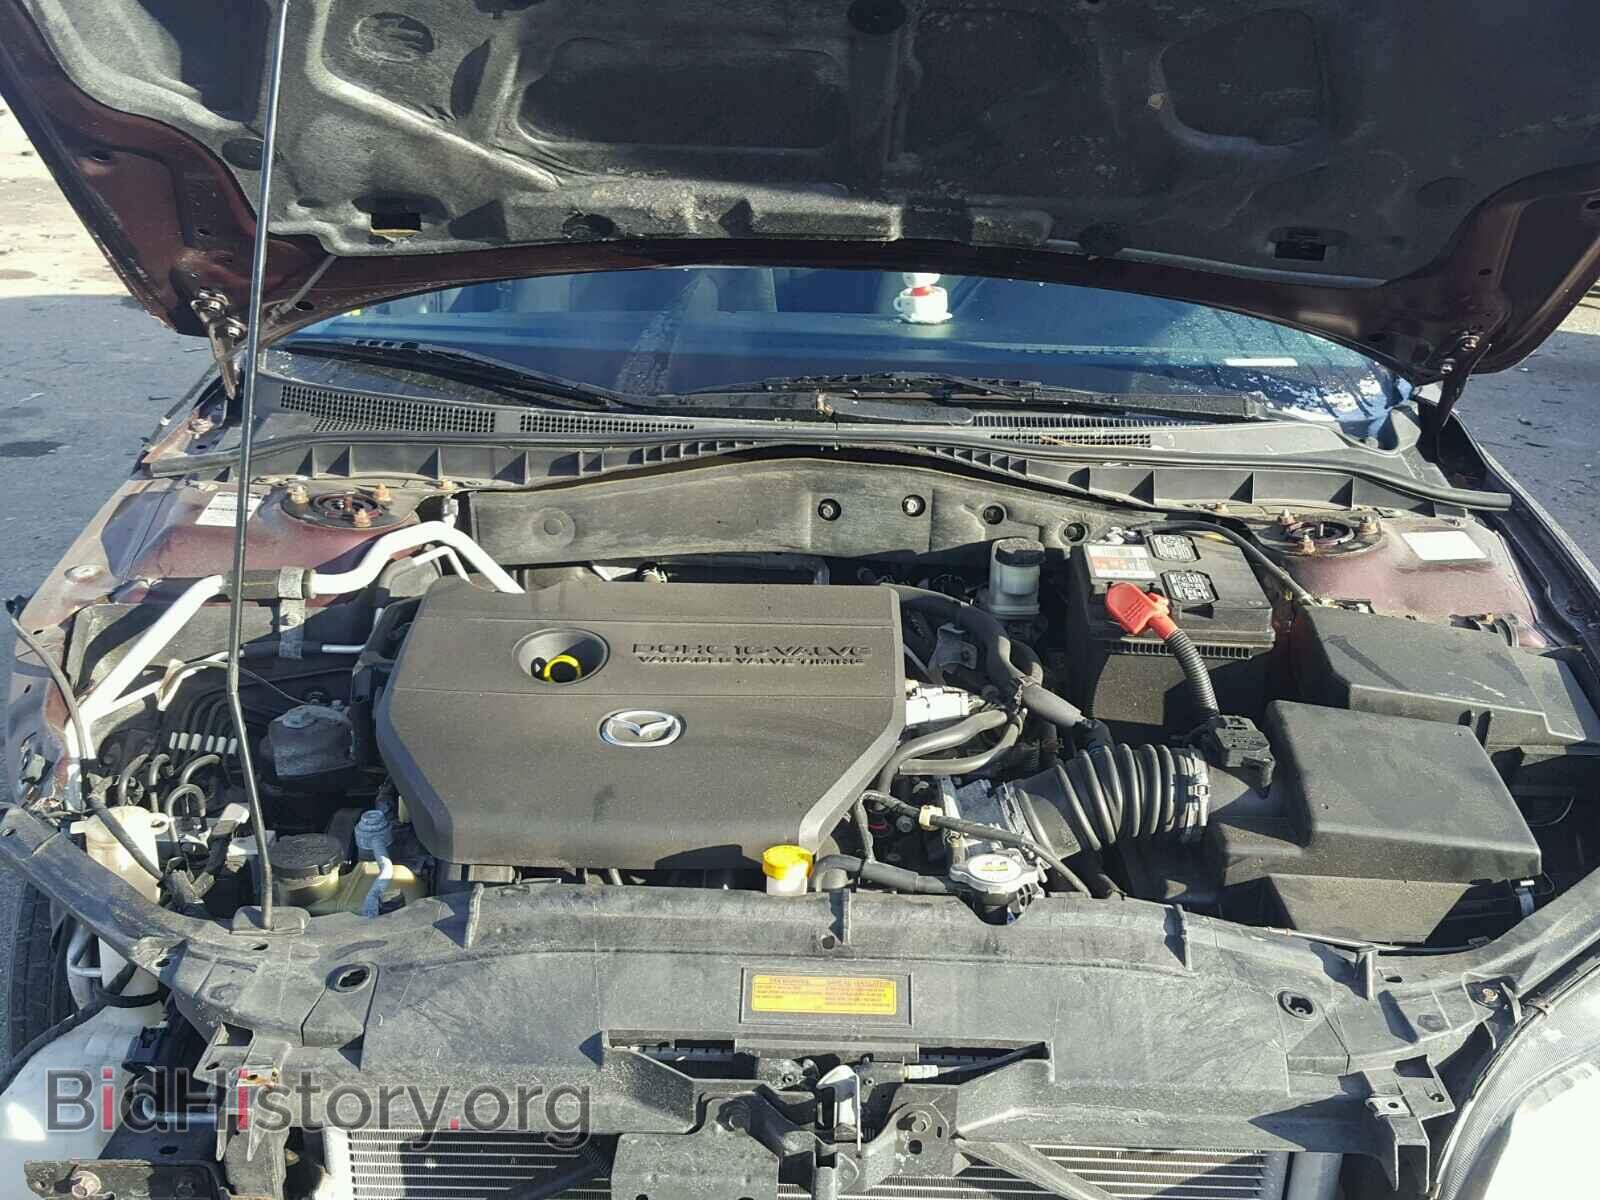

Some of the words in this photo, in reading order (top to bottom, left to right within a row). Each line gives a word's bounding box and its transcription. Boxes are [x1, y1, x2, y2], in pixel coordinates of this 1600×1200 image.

[632, 643, 729, 655] DOHC
[638, 655, 732, 664] VARIABLE
[735, 656, 796, 665] VALVE
